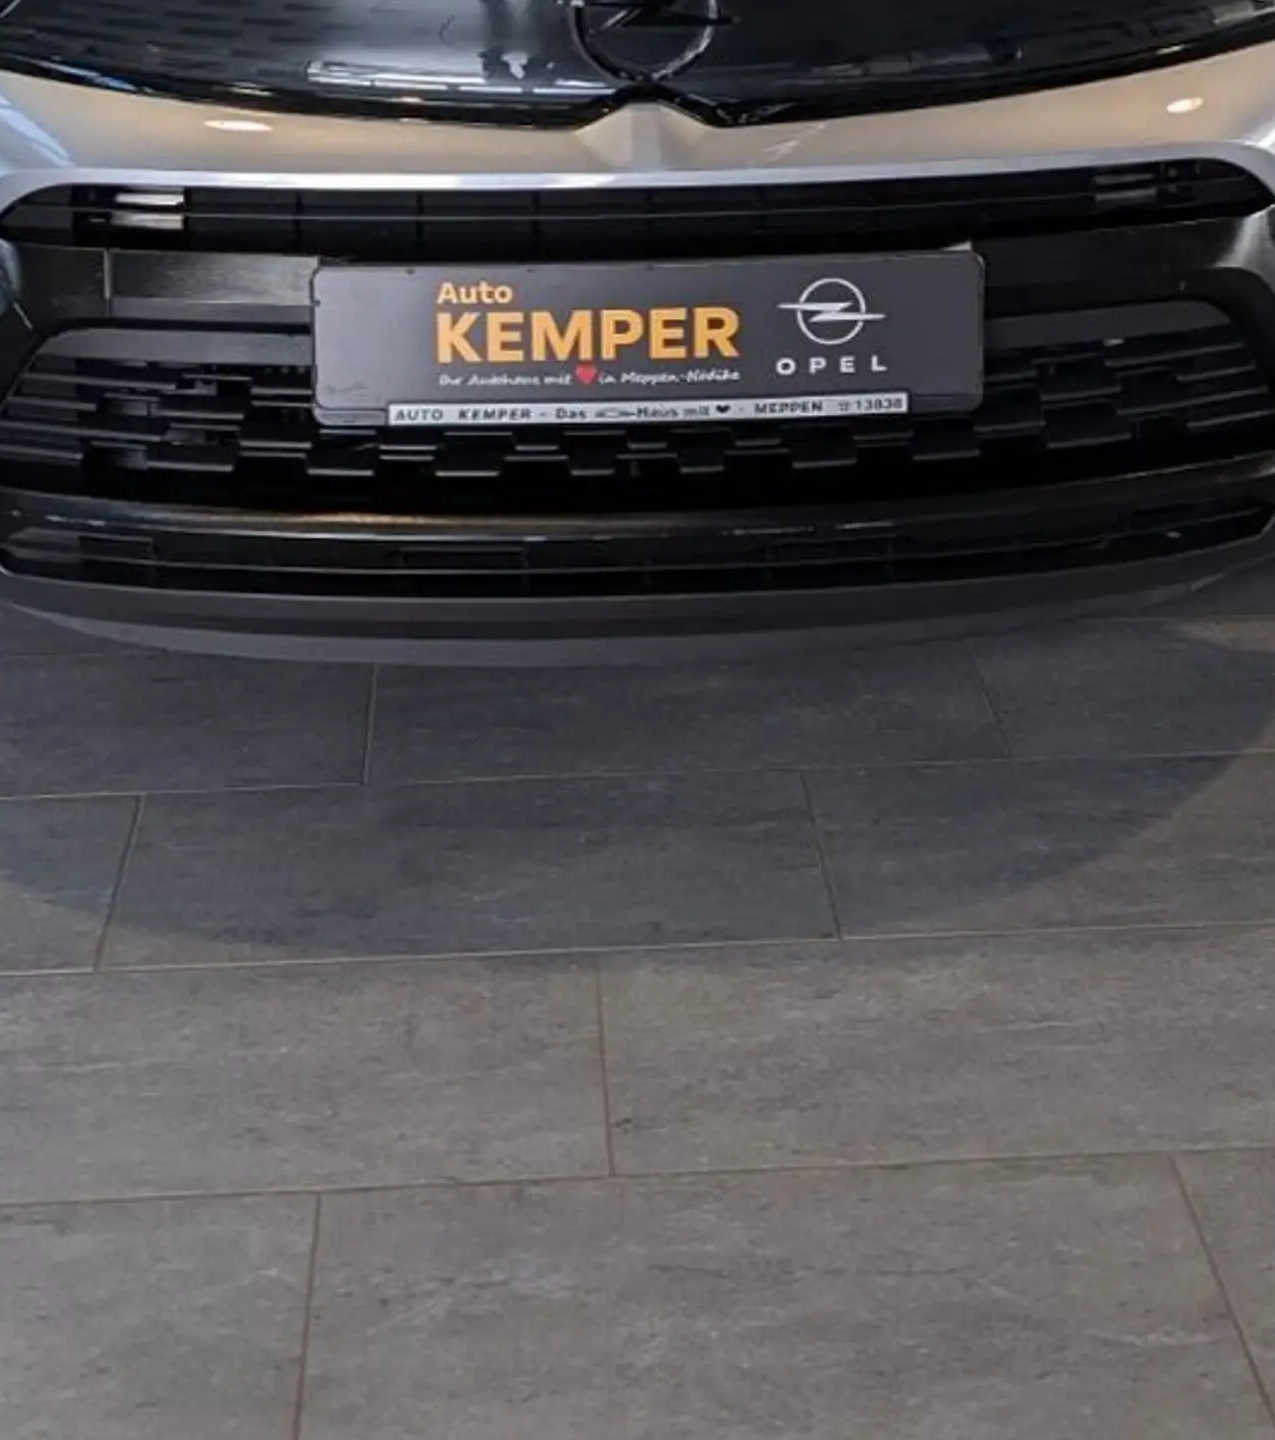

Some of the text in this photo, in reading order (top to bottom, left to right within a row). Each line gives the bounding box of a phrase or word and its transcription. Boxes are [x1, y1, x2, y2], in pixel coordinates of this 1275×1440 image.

[437, 281, 513, 305] Auto
[436, 305, 741, 363] KEMPER
[775, 355, 888, 376] OPEL
[544, 373, 572, 386] mit
[394, 408, 444, 422] AUTO
[458, 408, 533, 422] KEMPER
[555, 407, 587, 420] Das
[754, 400, 824, 416] MEPPEN
